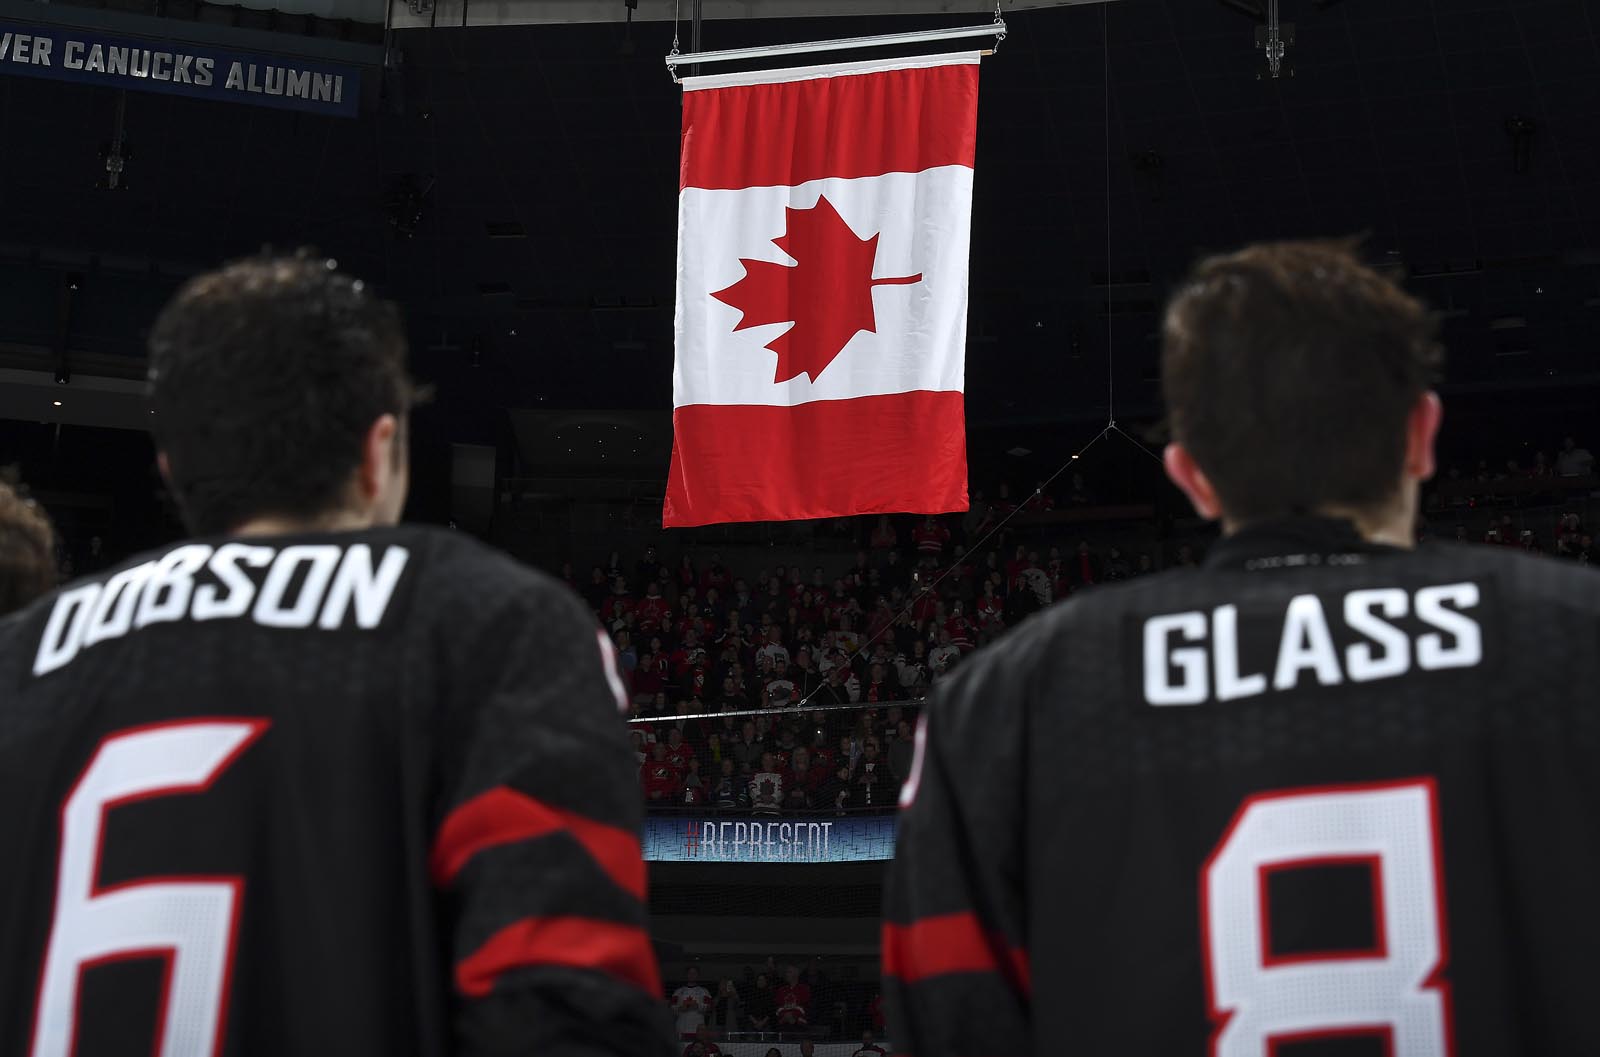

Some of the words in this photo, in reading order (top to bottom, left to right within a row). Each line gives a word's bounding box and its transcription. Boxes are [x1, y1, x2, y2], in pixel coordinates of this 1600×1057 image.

[63, 40, 215, 86] CANUCKS
[224, 61, 344, 103] ALUMNI
[32, 543, 410, 676] DOBSON
[1144, 582, 1482, 706] GLASS
[28, 716, 272, 1057] 6
[685, 821, 834, 858] #REPRESENT
[1199, 775, 1456, 1057] 8
